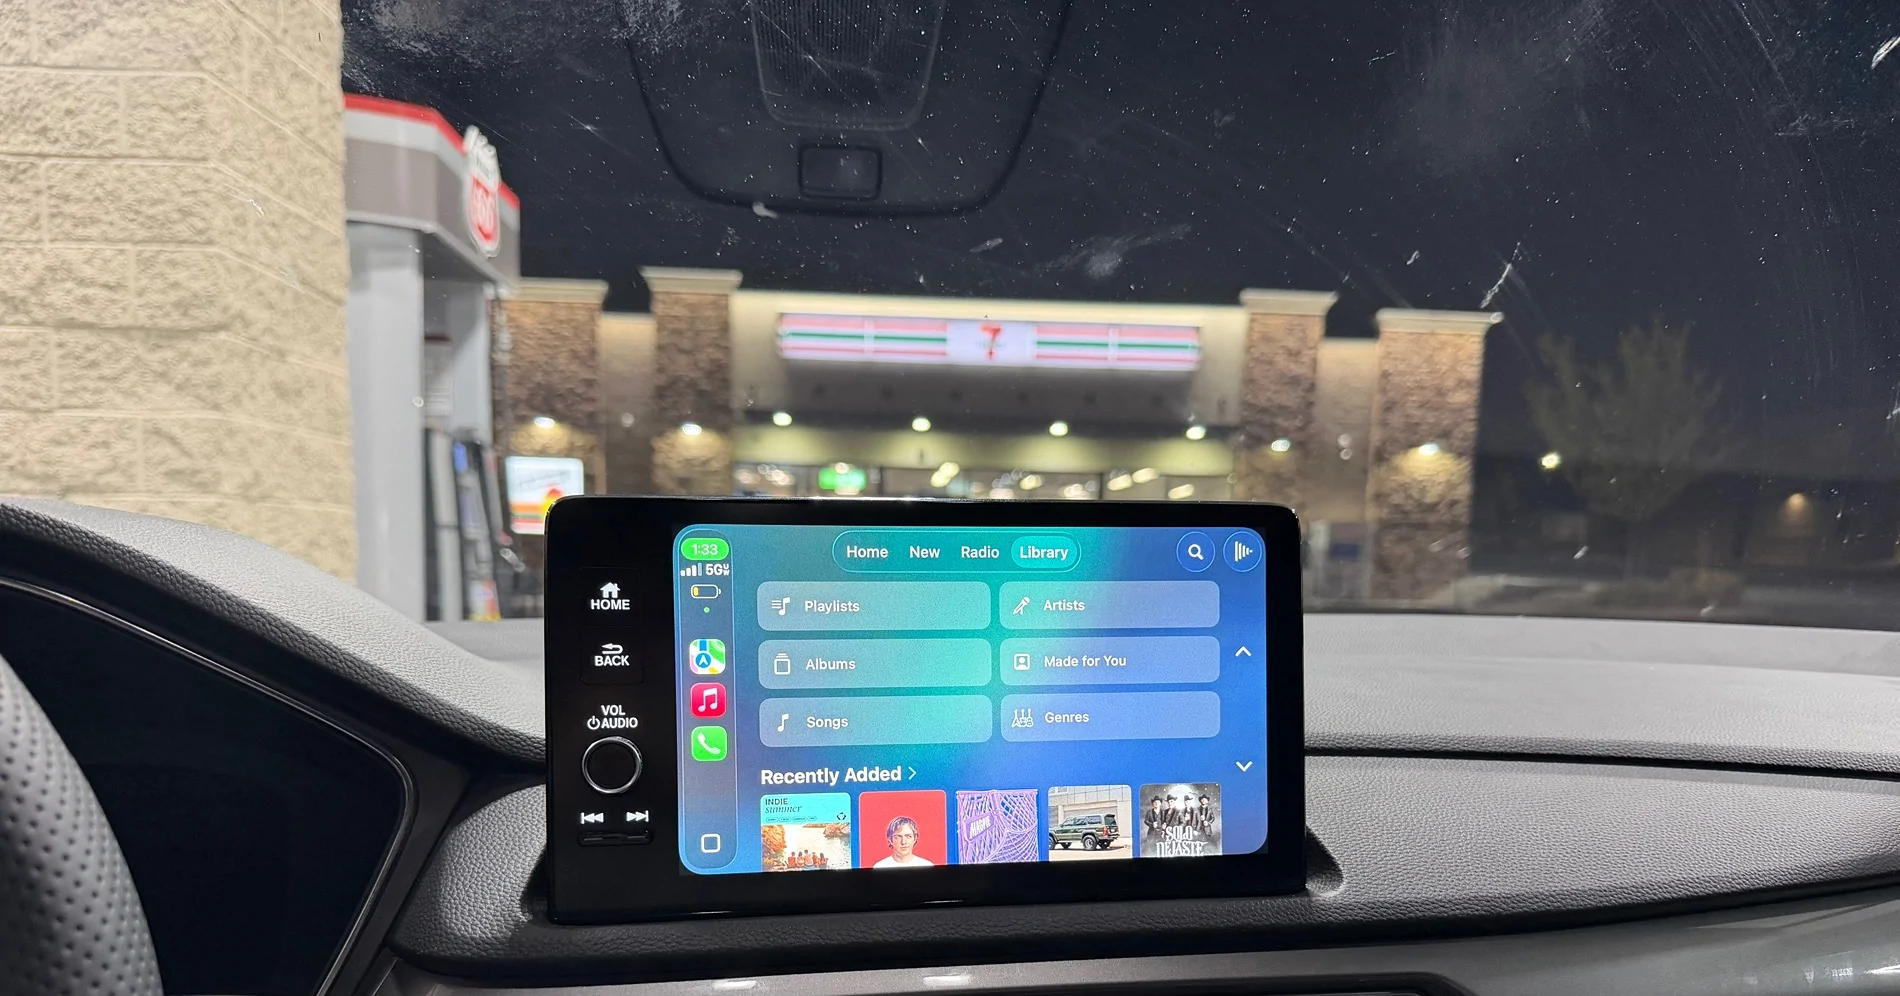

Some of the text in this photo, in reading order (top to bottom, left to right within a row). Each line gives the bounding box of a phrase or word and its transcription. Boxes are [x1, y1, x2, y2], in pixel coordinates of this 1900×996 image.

[692, 543, 718, 556] 1:33
[846, 545, 889, 559] Home
[909, 545, 940, 559] New
[961, 545, 1000, 559] Radio
[1019, 545, 1069, 561] Library
[590, 599, 631, 611] HOME
[804, 600, 860, 615] Playlists
[1043, 599, 1086, 612] Artists
[594, 655, 630, 667] BACK
[805, 658, 856, 671] Albums
[1044, 654, 1127, 668] Made for You
[600, 704, 626, 716] VOL
[601, 717, 639, 729] AUDIO
[806, 716, 849, 730] Songs
[1044, 711, 1090, 724] Genres
[761, 766, 902, 786] Recently Added
[765, 798, 788, 806] INDIE
[764, 805, 802, 813] summer
[1165, 825, 1193, 841] SOLO
